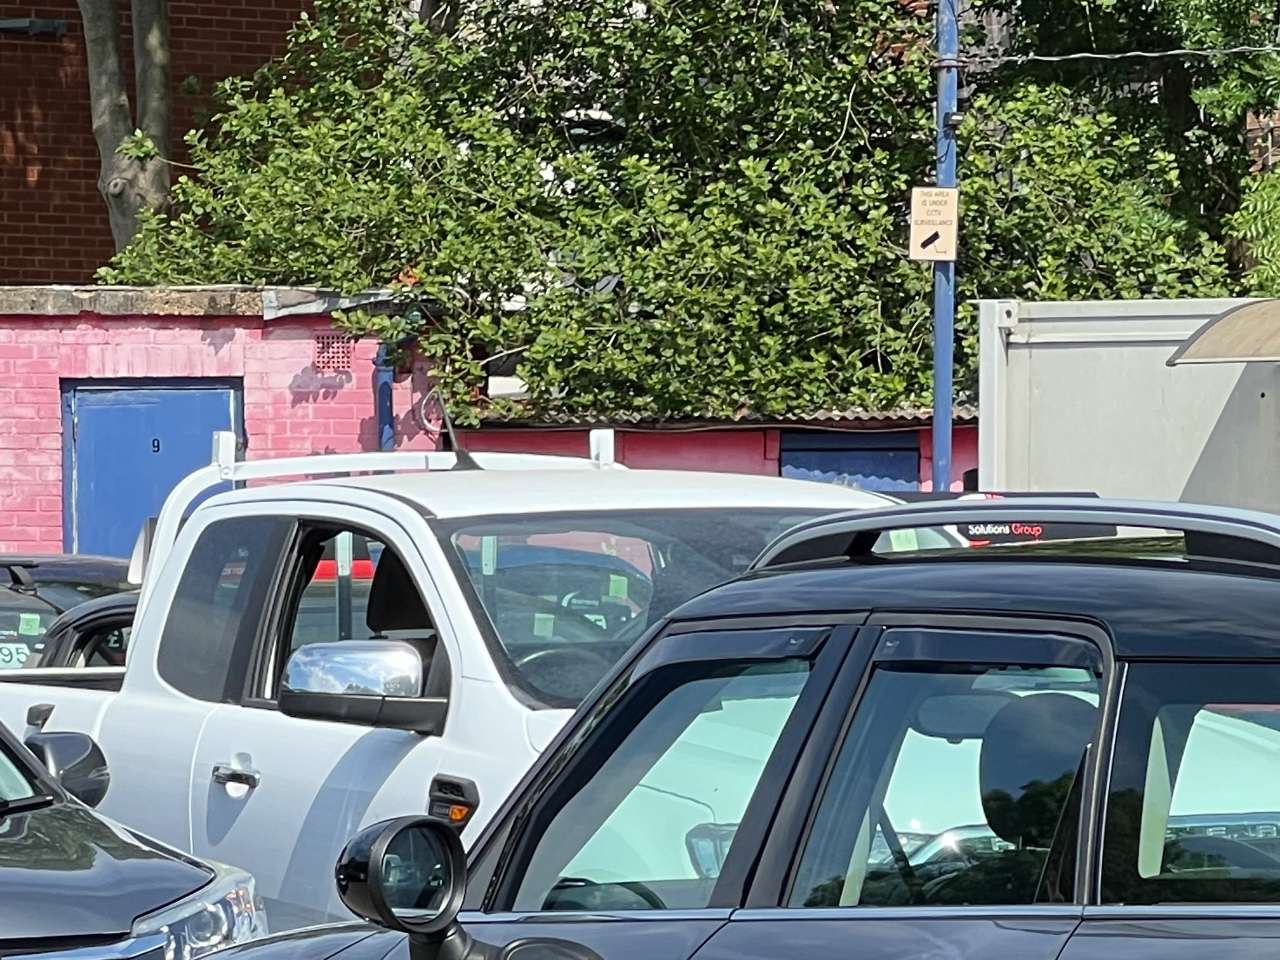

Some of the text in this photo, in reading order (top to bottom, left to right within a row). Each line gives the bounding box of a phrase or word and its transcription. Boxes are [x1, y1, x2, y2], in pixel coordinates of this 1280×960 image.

[152, 438, 160, 453] 9
[968, 523, 1042, 537] Solutions Group
